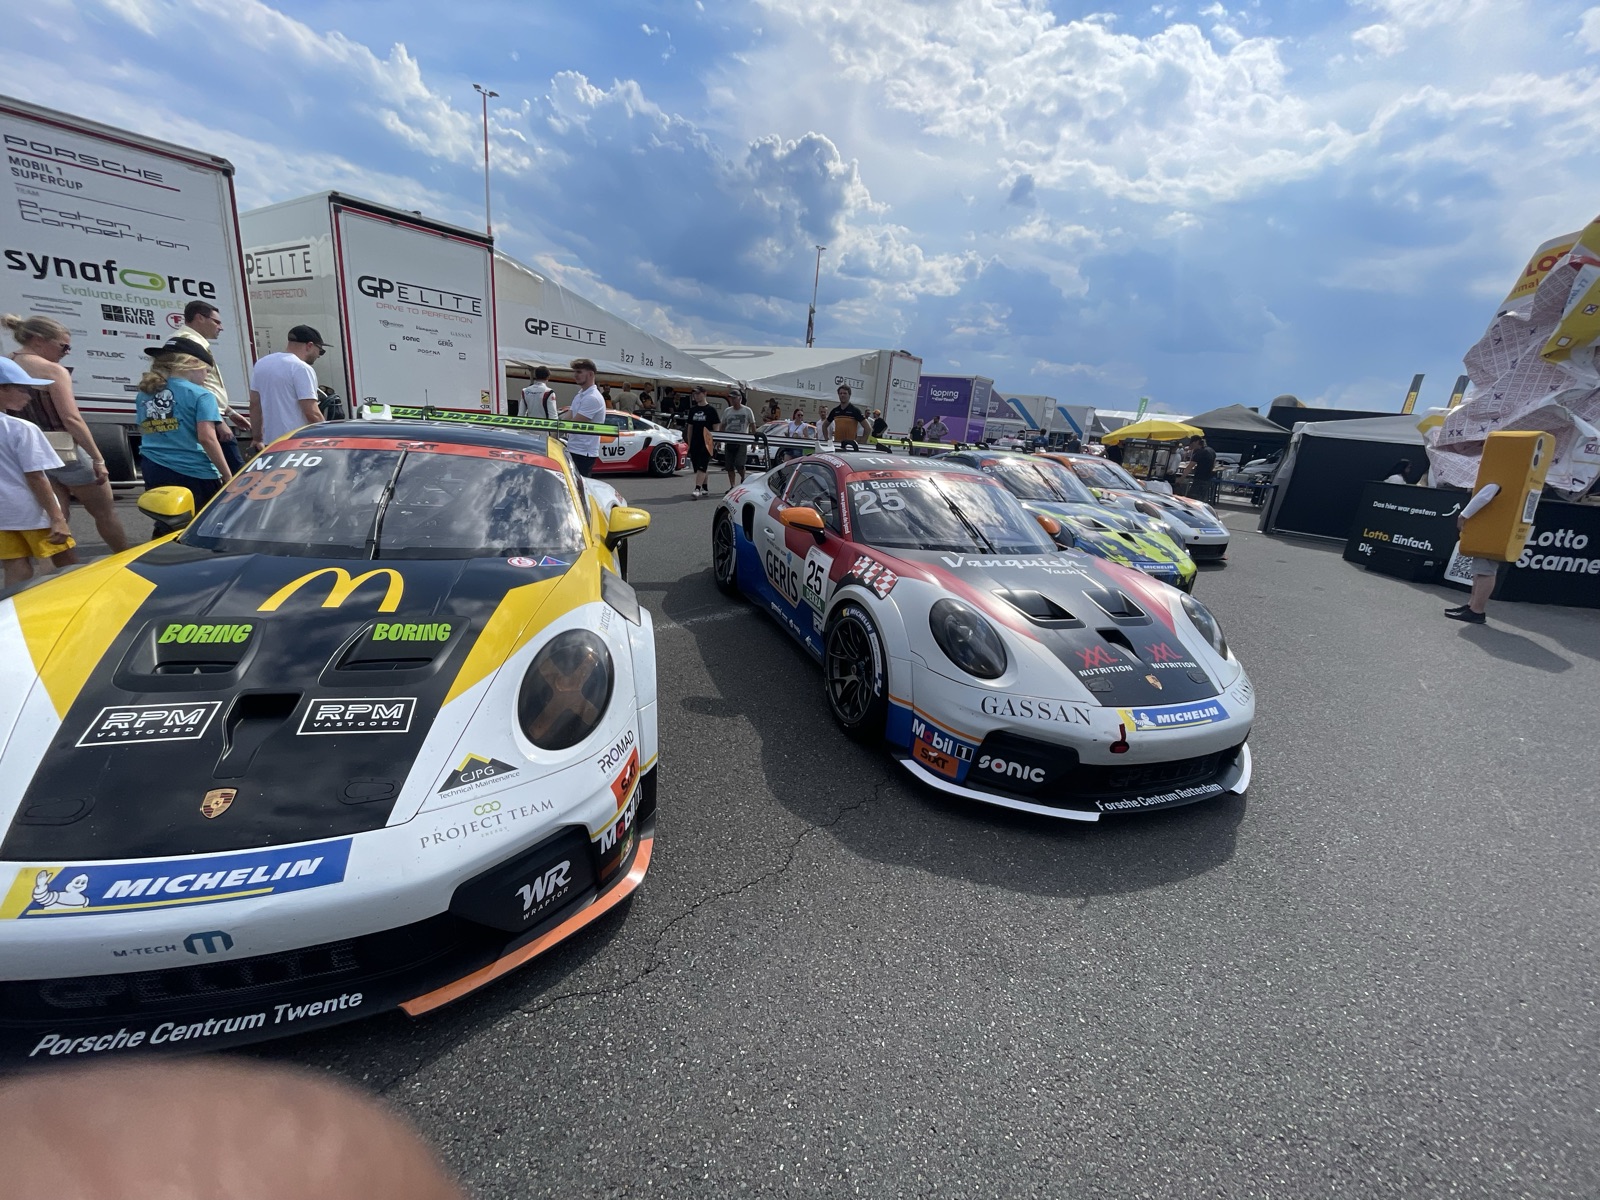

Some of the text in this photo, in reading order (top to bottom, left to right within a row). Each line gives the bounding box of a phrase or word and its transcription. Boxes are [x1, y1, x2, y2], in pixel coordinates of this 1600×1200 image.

[3, 134, 163, 183] PORSCHE
[8, 155, 63, 176] MOBIL 1
[11, 167, 83, 191] SUPERCUP
[18, 199, 131, 231] Proton
[20, 209, 190, 251] Competition
[124, 307, 154, 321] EVER
[125, 315, 156, 327] NINE
[376, 302, 473, 324] DRIVE TO PERFECTION
[87, 350, 126, 359] STALOC
[625, 354, 635, 363] 27
[645, 358, 654, 367] 26
[664, 361, 673, 370] 25
[930, 387, 959, 400] looping
[300, 439, 343, 449] SIXT
[396, 442, 439, 451] SIXT
[602, 444, 626, 457] twe
[246, 453, 323, 473] N. Ho
[489, 450, 527, 461] SIXT
[869, 471, 894, 479] SIXT
[221, 468, 298, 504] 98
[850, 483, 869, 492] W.
[854, 488, 906, 516] 25
[1373, 500, 1385, 509] Das
[1385, 502, 1397, 510] hier
[1410, 507, 1437, 517] gestern
[1363, 528, 1434, 551] Lotto. Einfach.
[1525, 525, 1589, 550] Lotto
[941, 557, 1087, 569] Vanquish
[1142, 562, 1175, 571] MICHELIN
[765, 548, 800, 604] GERIS
[806, 559, 825, 596] 25
[802, 586, 823, 611] DEKRA
[849, 607, 873, 632] MICHELIN
[157, 623, 253, 644] BORING
[372, 623, 452, 642] BORING
[1078, 664, 1133, 677] NUTRITION
[1151, 660, 1198, 670] NUTRITION
[103, 708, 205, 731] RPM
[315, 703, 405, 721] RPM
[981, 695, 1091, 727] GASSAN
[1156, 706, 1219, 724] MICHELIN
[97, 727, 196, 739] VASTGOED
[313, 720, 400, 729] VASTGOED
[912, 718, 953, 755] Mobil
[597, 729, 635, 774] PROMAD
[920, 747, 949, 770] SIXT
[460, 765, 495, 784] CJPG
[620, 760, 637, 796] SIXT
[439, 771, 520, 800] Technical Maintenance
[1137, 791, 1181, 807] Centrum
[1175, 783, 1223, 799] Rotterdam
[420, 799, 556, 849] PROJECT TEAM
[600, 797, 636, 855] Mobil
[102, 856, 325, 900] MICHELIN
[515, 860, 572, 911] WR
[523, 886, 569, 920] WRAPTOR
[29, 991, 363, 1057] Porsche Centrum Twente
